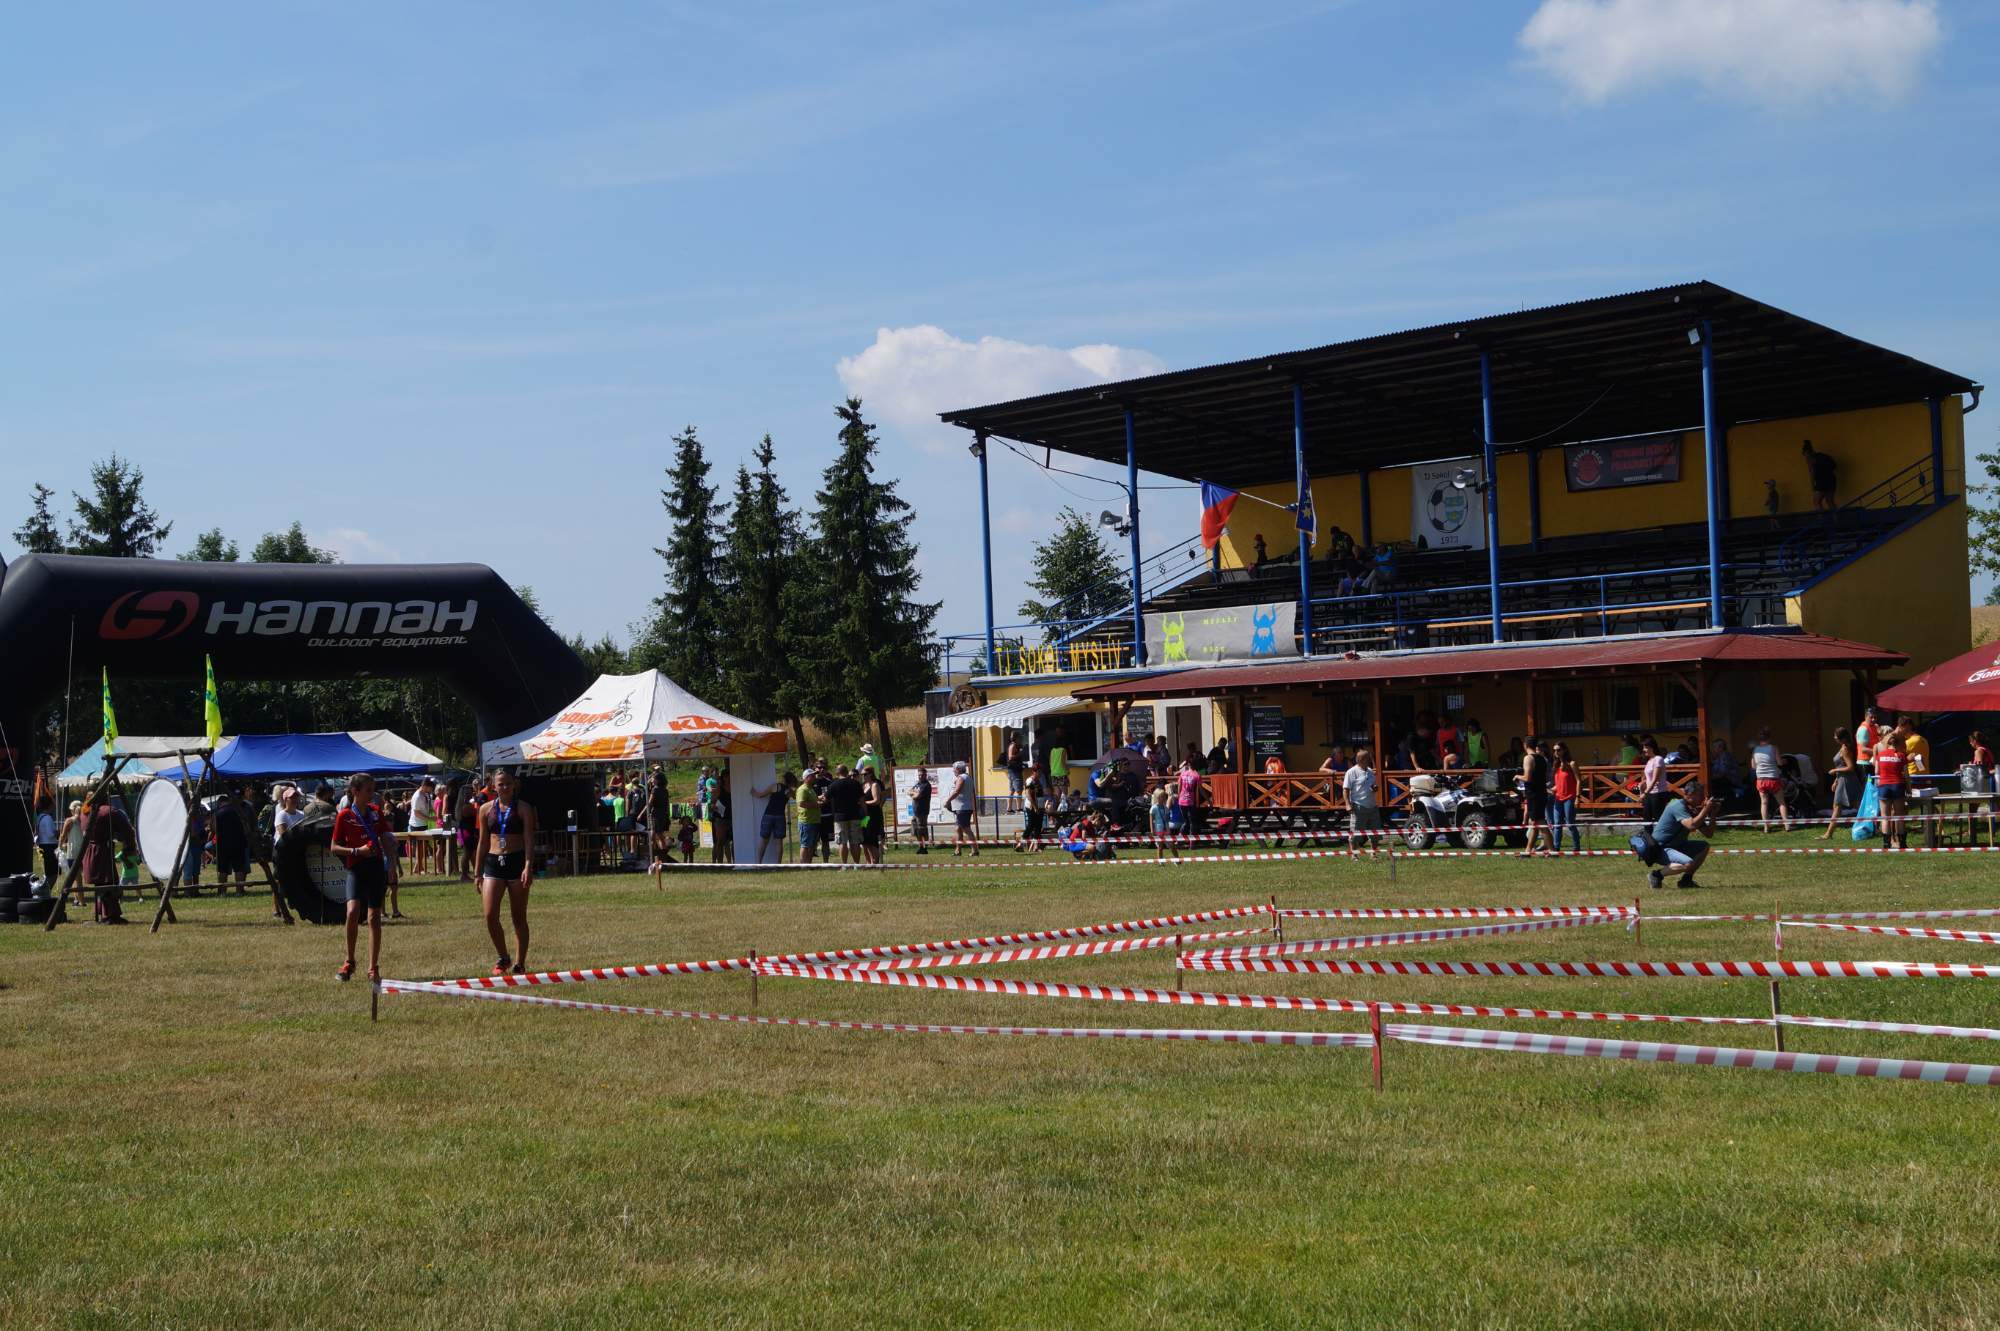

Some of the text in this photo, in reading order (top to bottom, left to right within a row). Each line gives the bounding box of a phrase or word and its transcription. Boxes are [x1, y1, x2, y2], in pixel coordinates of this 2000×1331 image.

[382, 635, 468, 649] equipment
[994, 646, 1011, 676] TJ
[1019, 643, 1062, 675] SOKOL
[668, 715, 741, 731] KTM
